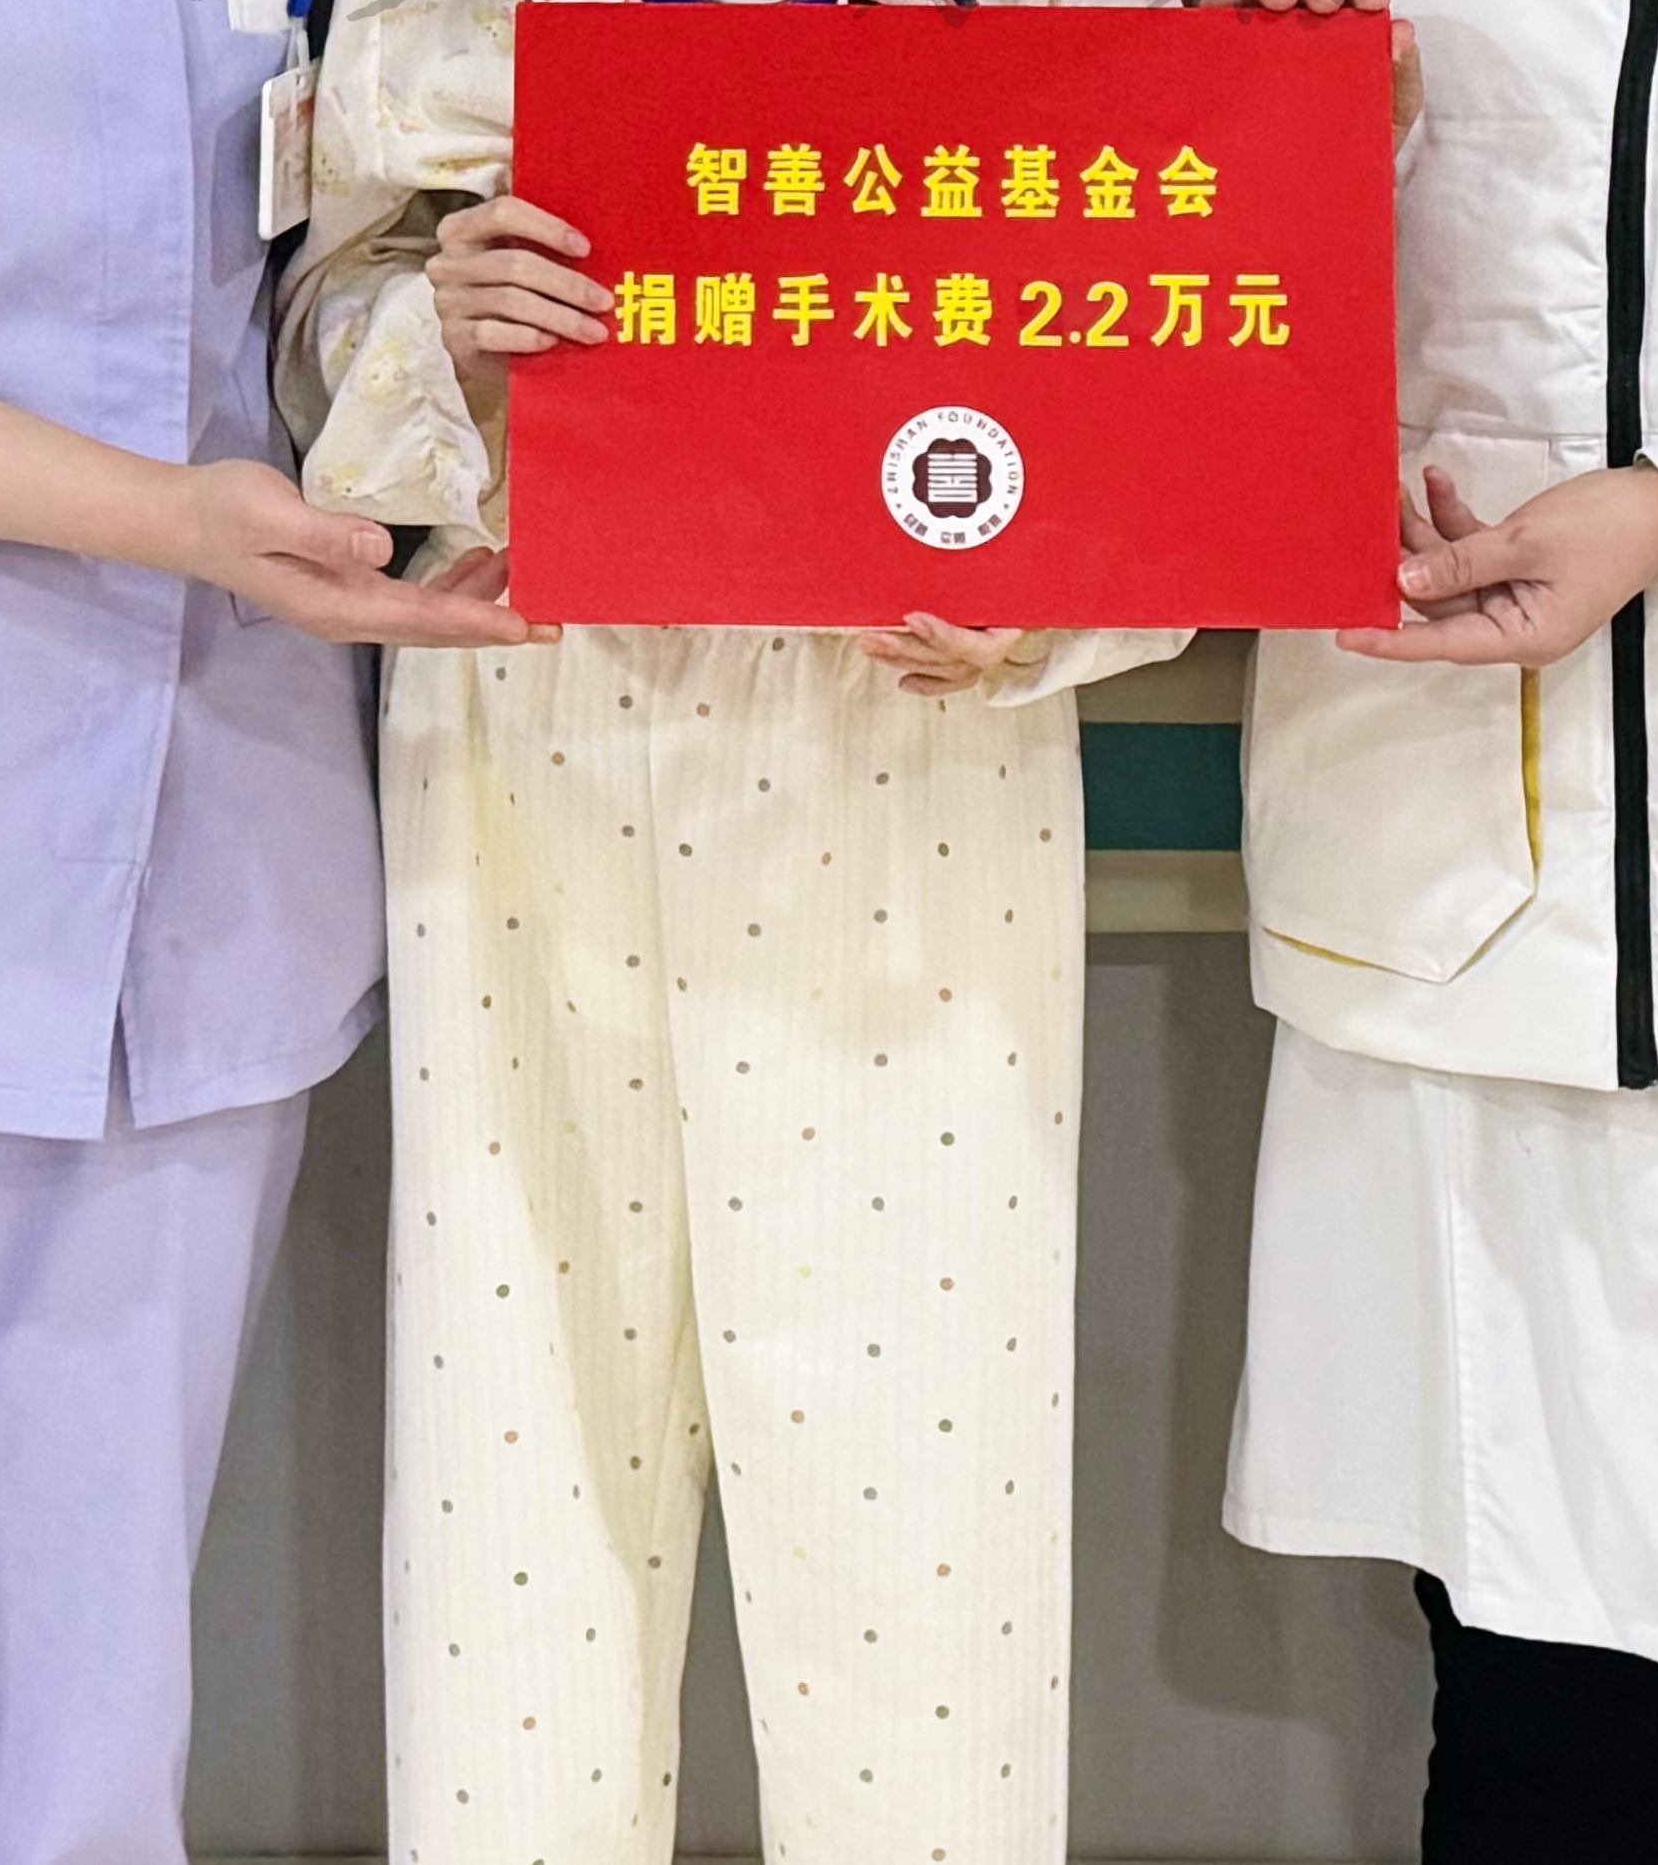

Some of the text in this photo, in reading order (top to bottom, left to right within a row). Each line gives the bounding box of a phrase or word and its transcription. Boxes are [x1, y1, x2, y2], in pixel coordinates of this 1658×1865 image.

[685, 142, 1219, 219] 智善公益基金会
[614, 271, 1291, 349] 捐赠手术费2.2万元
